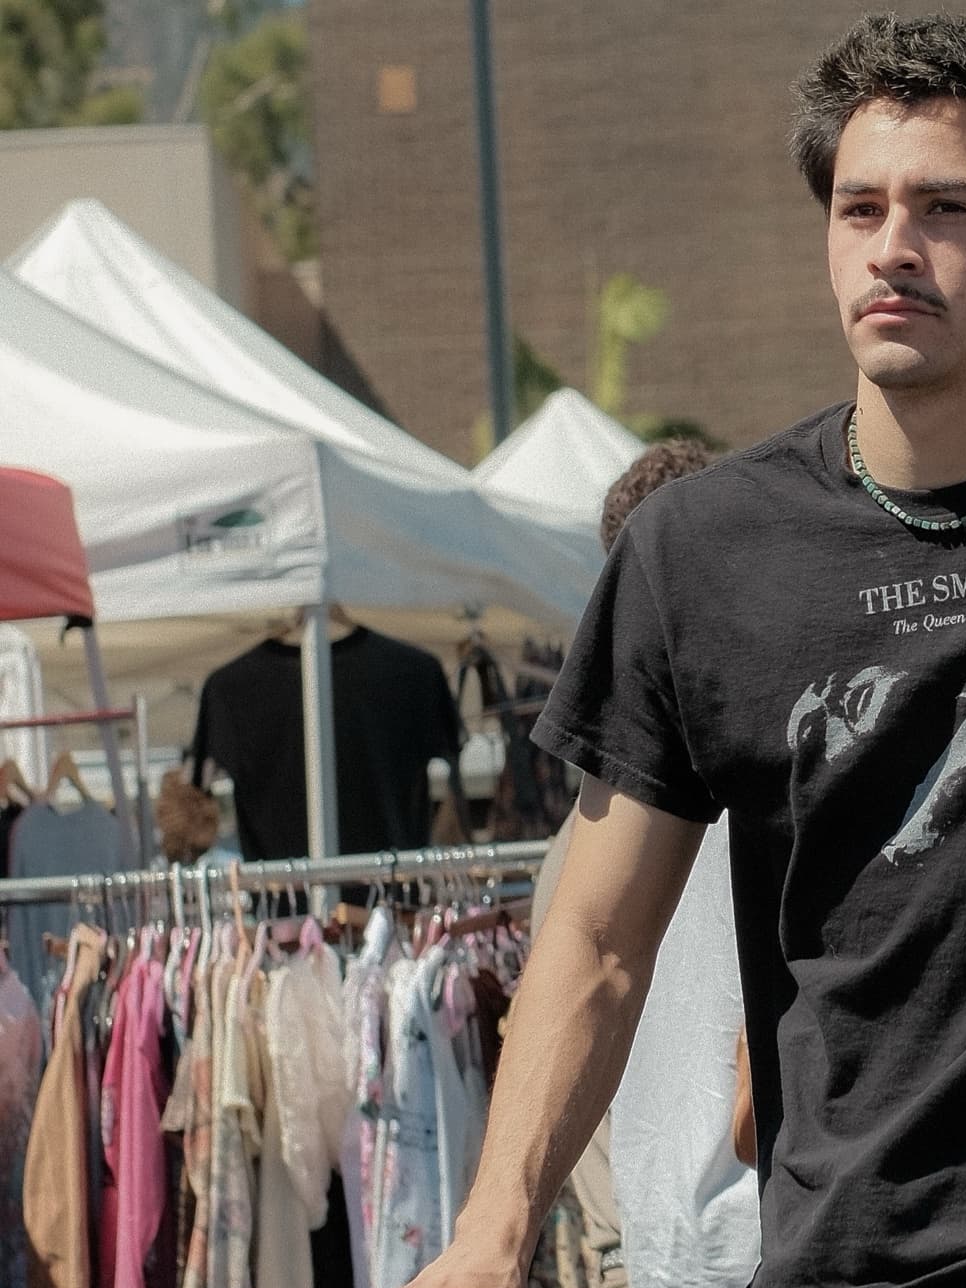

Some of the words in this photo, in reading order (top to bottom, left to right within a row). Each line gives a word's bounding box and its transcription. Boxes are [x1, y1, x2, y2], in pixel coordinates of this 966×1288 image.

[858, 579, 927, 616] THE
[892, 617, 919, 636] The
[923, 611, 966, 633] Queen
